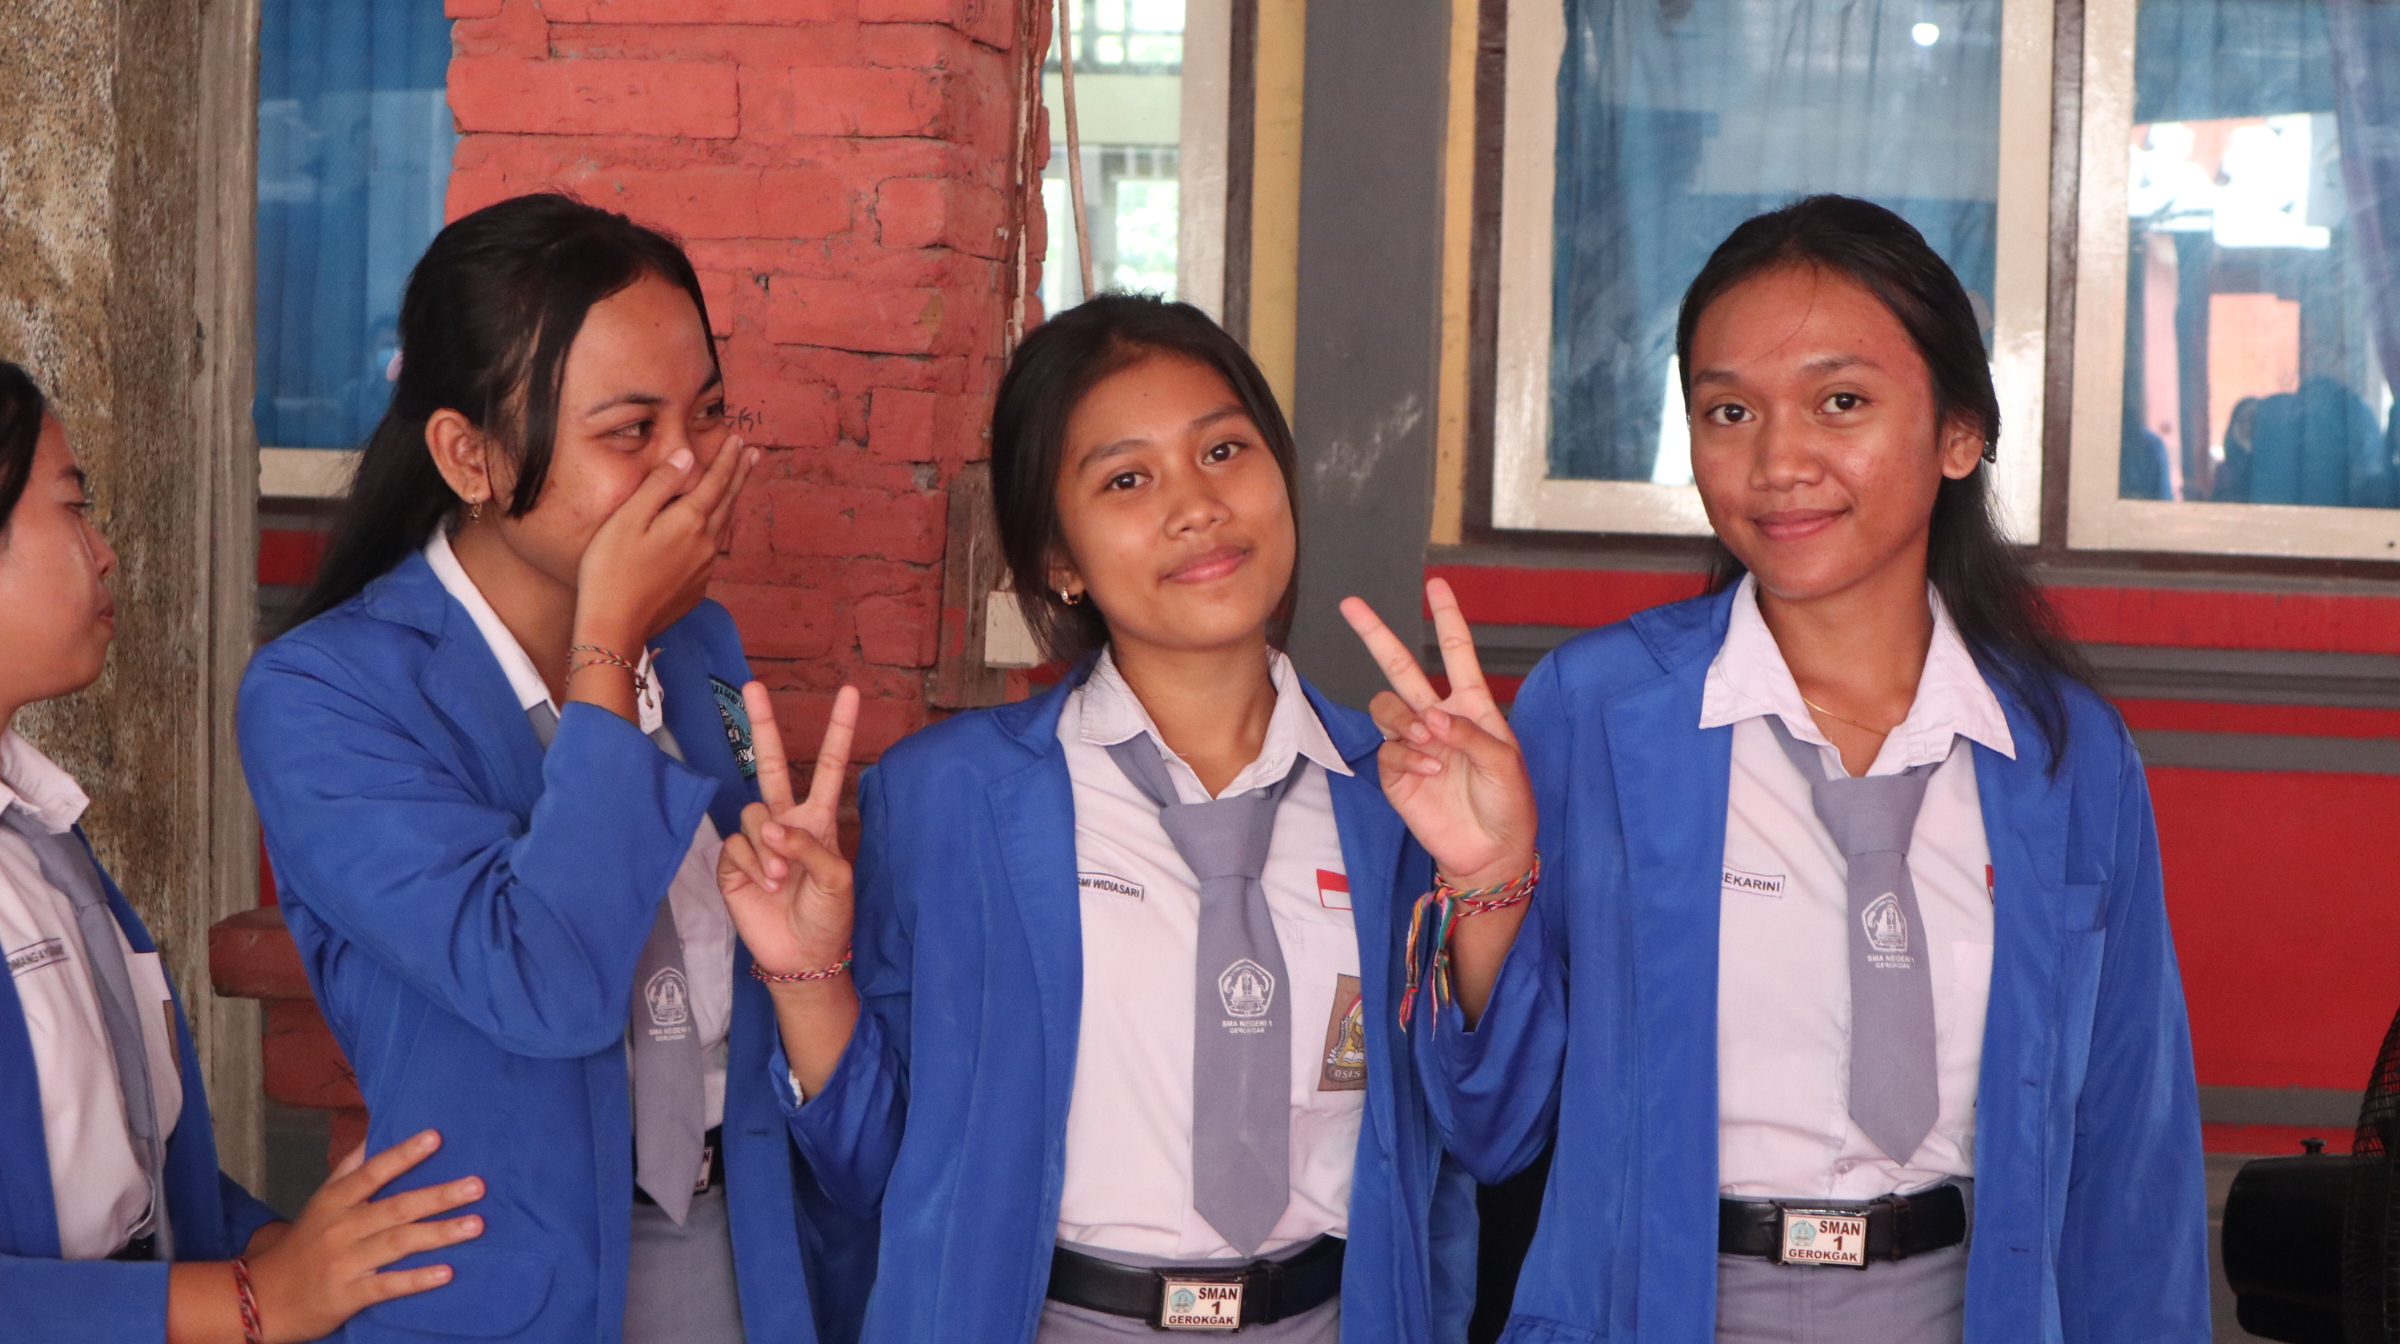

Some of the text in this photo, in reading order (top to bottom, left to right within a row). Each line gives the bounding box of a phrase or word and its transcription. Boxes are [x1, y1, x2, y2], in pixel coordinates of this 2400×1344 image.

[1093, 879, 1140, 898] WIDIASARI
[1722, 872, 1781, 892] EKARINI
[1334, 1069, 1361, 1079] OSIS
[1819, 1220, 1860, 1236] SMAN
[1833, 1235, 1843, 1251] 1
[1788, 1249, 1858, 1262] GEROKGAK
[1198, 1287, 1238, 1300] SMAN
[1211, 1301, 1221, 1315] 1
[1168, 1315, 1235, 1325] GEROKGAK
